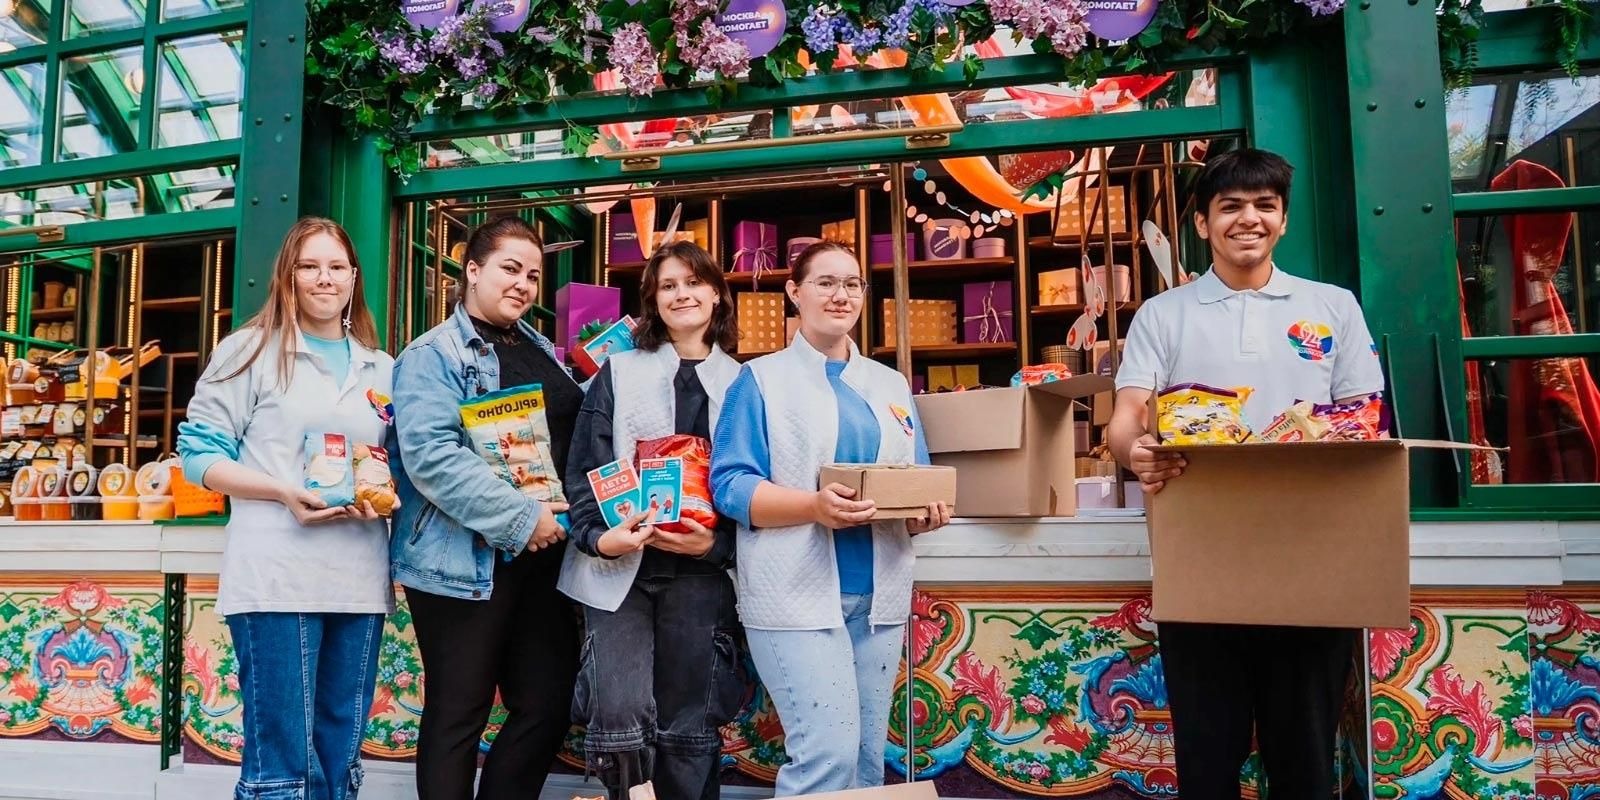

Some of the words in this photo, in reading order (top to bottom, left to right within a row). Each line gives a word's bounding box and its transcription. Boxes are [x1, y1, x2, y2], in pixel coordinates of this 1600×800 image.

[406, 1, 446, 13] ПОМОГАЕТ
[722, 11, 761, 22] МОСКВА
[478, 398, 538, 419] ВЫГОДНО
[601, 474, 629, 492] ЛЕТО
